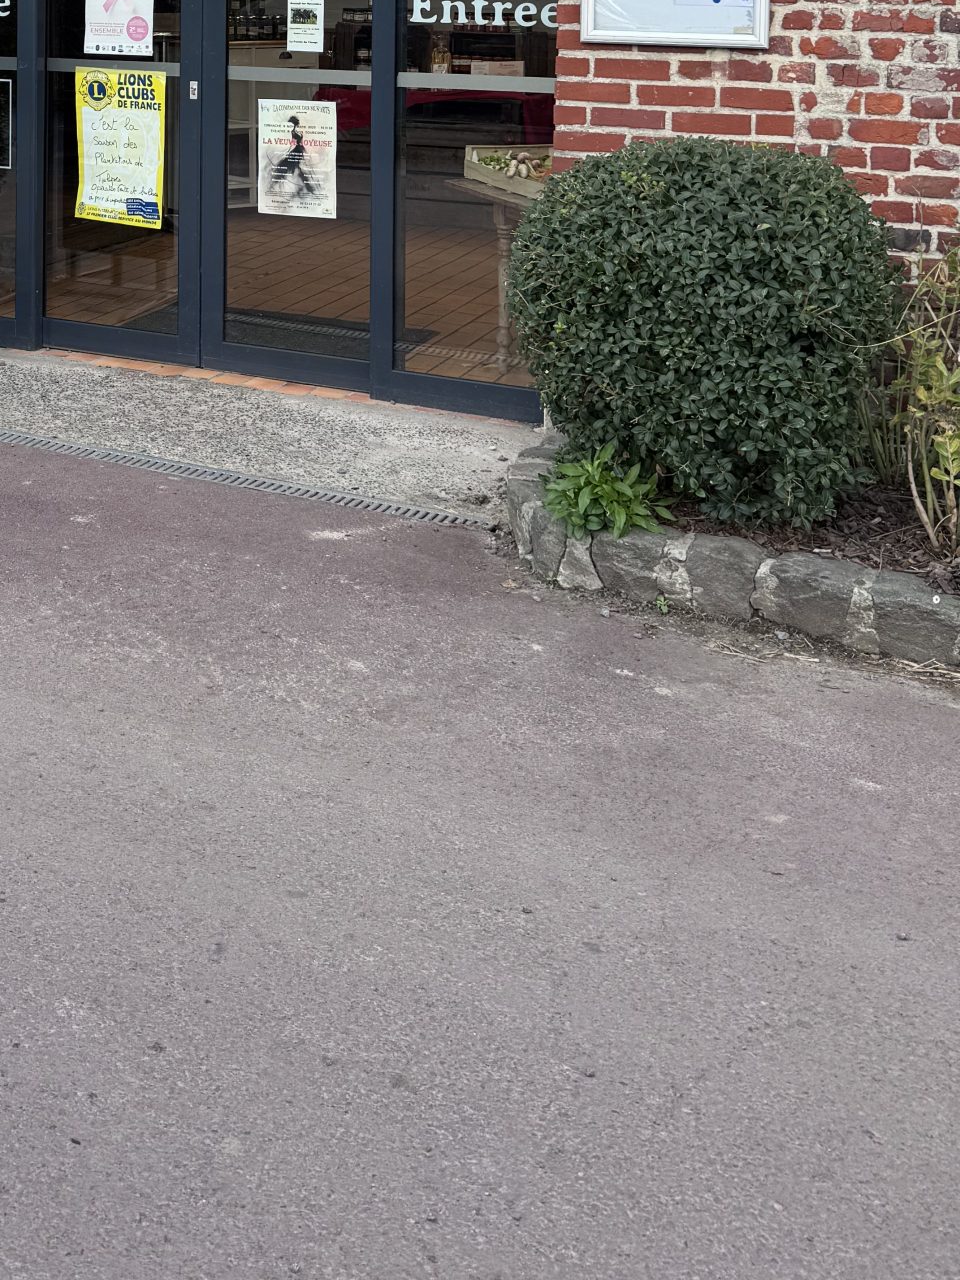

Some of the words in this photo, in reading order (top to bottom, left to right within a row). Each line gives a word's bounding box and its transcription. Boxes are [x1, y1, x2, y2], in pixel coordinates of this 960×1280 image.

[117, 73, 153, 87] LIONS
[117, 86, 156, 101] CLUBS
[117, 99, 128, 109] DE
[130, 100, 162, 112] FRANCE
[124, 116, 140, 131] la
[262, 137, 273, 145] LA
